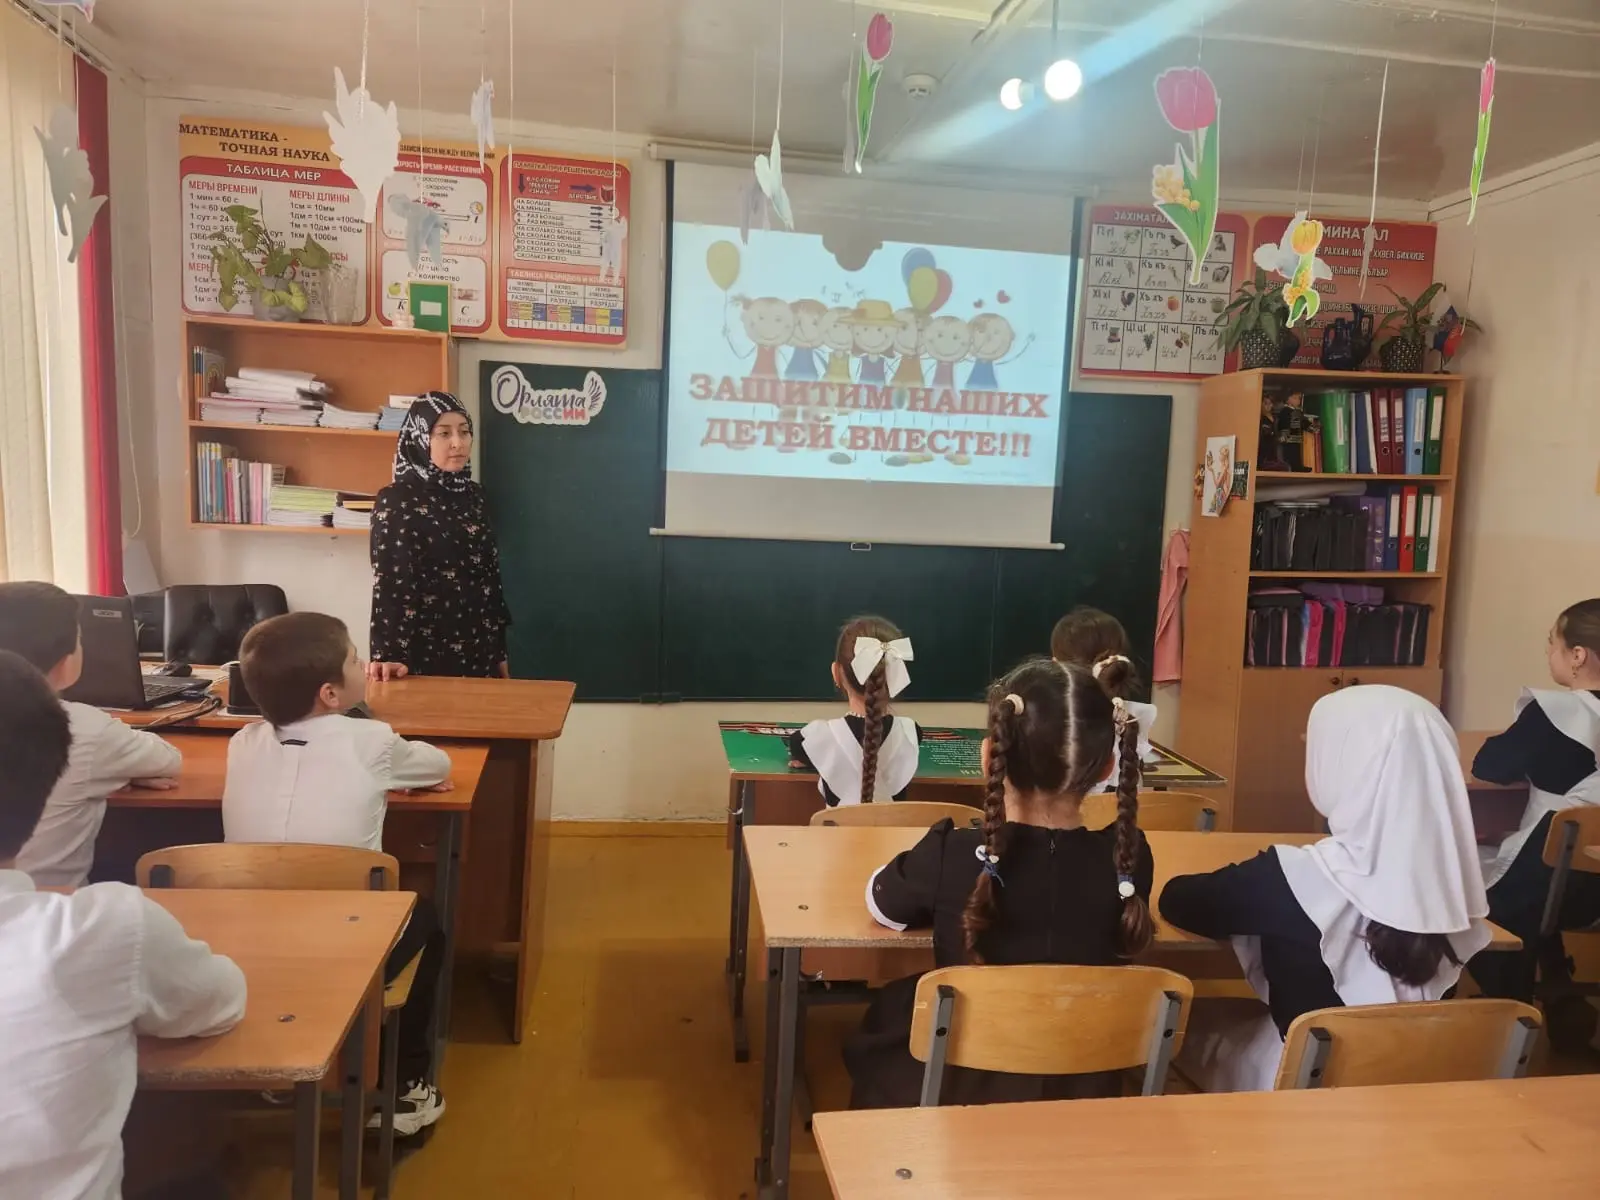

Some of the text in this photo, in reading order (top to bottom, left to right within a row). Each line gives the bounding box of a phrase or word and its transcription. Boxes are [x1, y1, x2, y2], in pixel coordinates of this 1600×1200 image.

[179, 123, 279, 143] МАТЕМАТИКА
[219, 142, 330, 162] ТОЧНАЯ НАУКА
[460, 150, 496, 159] ВЕЛИЧАМИ
[226, 163, 321, 181] ТАБЛИЦА МЕР
[189, 180, 258, 195] МЕРЫ ВРЕМЕНИ
[222, 195, 232, 203] 60
[289, 189, 350, 204] МЕРЫ ДЛИНЫ
[208, 204, 218, 212] 60
[315, 204, 335, 212] 10мм
[196, 214, 211, 222] сут
[315, 214, 334, 222] 10см
[221, 225, 234, 233] 365
[310, 223, 330, 231] 10дм
[339, 225, 363, 234] 100см
[1322, 225, 1389, 241] МИНАТАЛ
[314, 232, 338, 241] 1000м
[330, 252, 348, 261] ССЫ
[420, 256, 459, 264] стоость
[688, 373, 1050, 418] ЗАЩИТИМ НАШИХ
[700, 415, 1032, 458] ДЕТЕЙ ВМЕСТЕ!!!
